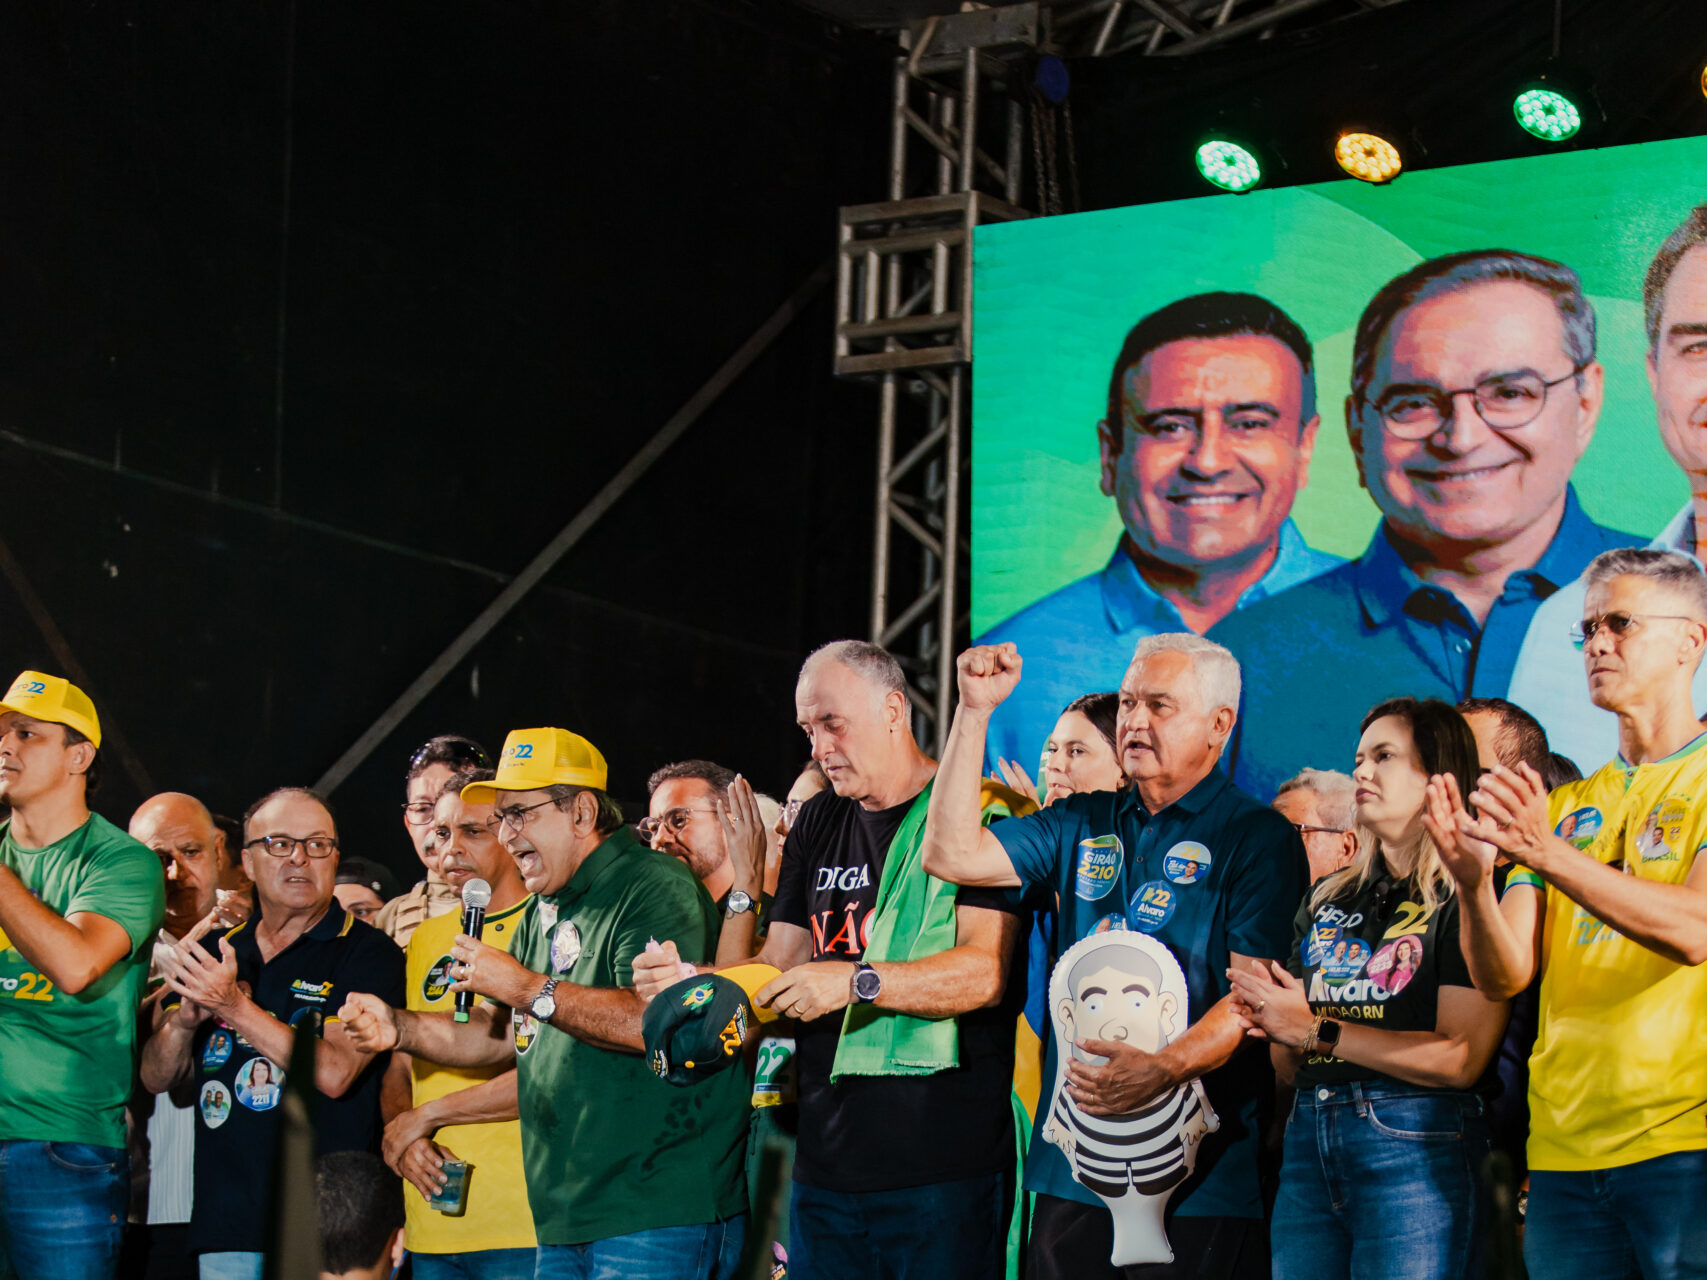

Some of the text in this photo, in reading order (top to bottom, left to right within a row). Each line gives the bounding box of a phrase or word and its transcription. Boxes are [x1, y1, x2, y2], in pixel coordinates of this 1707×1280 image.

[515, 744, 533, 758] 22
[1181, 846, 1201, 860] 22
[816, 863, 870, 891] DIGA
[1078, 861, 1115, 880] 2210
[1151, 889, 1171, 907] 22
[1383, 901, 1429, 939] 22
[1318, 927, 1337, 940] 22
[14, 972, 54, 1001] 22
[1363, 1004, 1384, 1019] RN
[755, 1046, 792, 1085] 22
